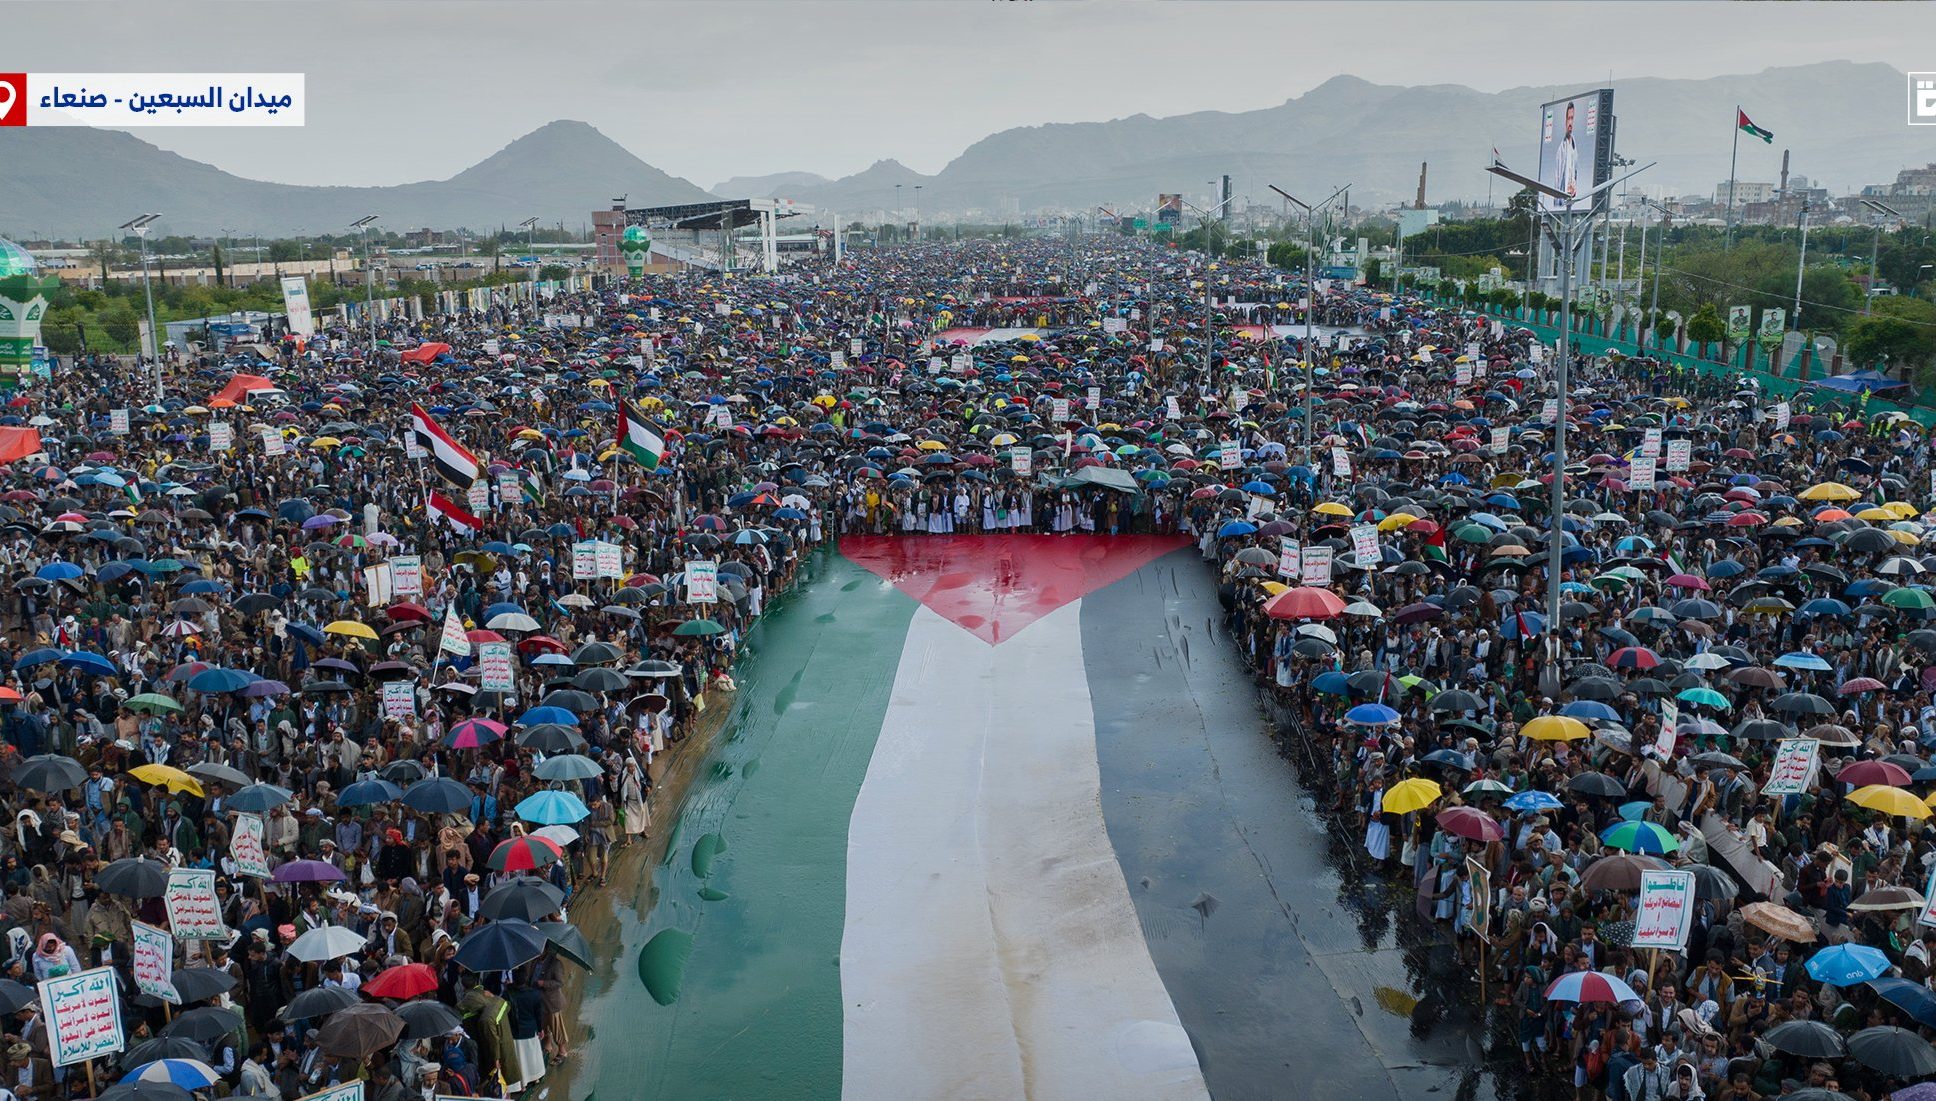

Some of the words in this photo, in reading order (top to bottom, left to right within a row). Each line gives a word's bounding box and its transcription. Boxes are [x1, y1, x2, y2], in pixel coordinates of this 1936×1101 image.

[89, 977, 109, 991] الله
[88, 994, 112, 1007] الموت
[91, 1008, 113, 1021] الموت
